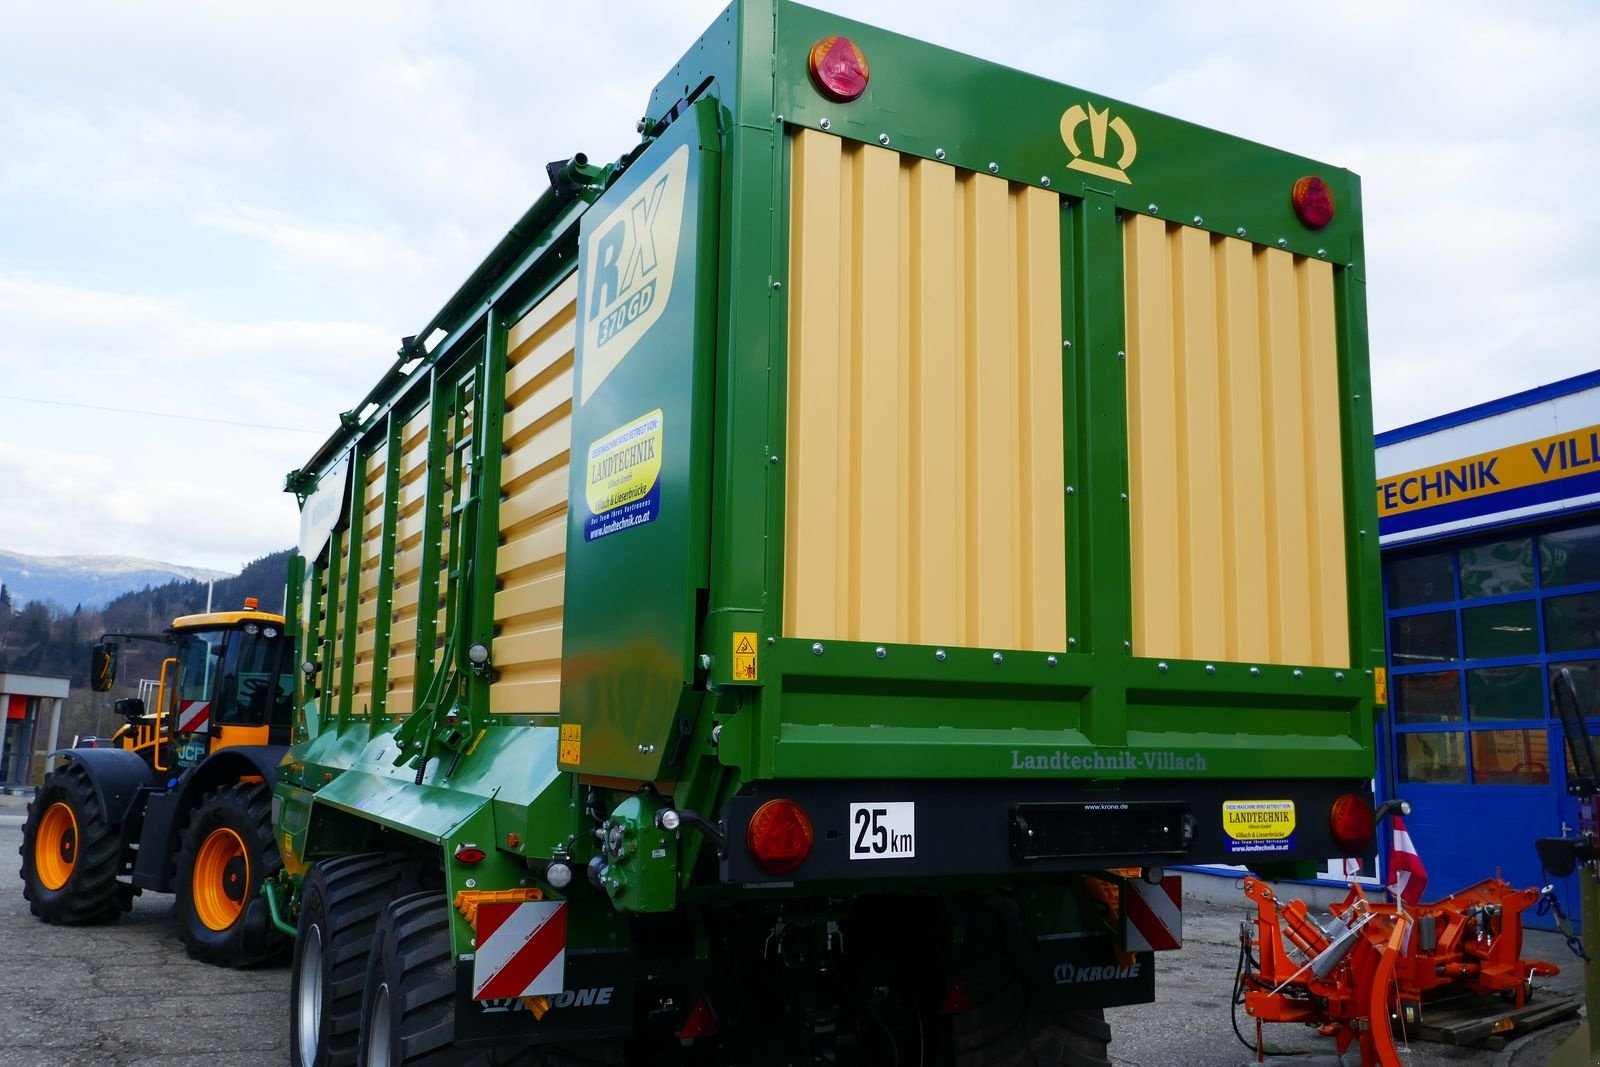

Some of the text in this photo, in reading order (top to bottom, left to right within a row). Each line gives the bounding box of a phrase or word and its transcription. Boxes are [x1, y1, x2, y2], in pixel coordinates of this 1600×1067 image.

[589, 173, 669, 322] RX
[600, 286, 653, 345] 370 GD
[591, 437, 655, 485] LANDTECHNIK
[614, 483, 647, 505] Lieserbrücke
[590, 510, 651, 539] www.landtechnik.co.at
[1011, 750, 1207, 771] Landtechnik-Villach
[854, 808, 912, 854] 25 km
[1229, 811, 1290, 823] LANDTECHNIK
[1231, 844, 1289, 852] www.landtechnik.co.at
